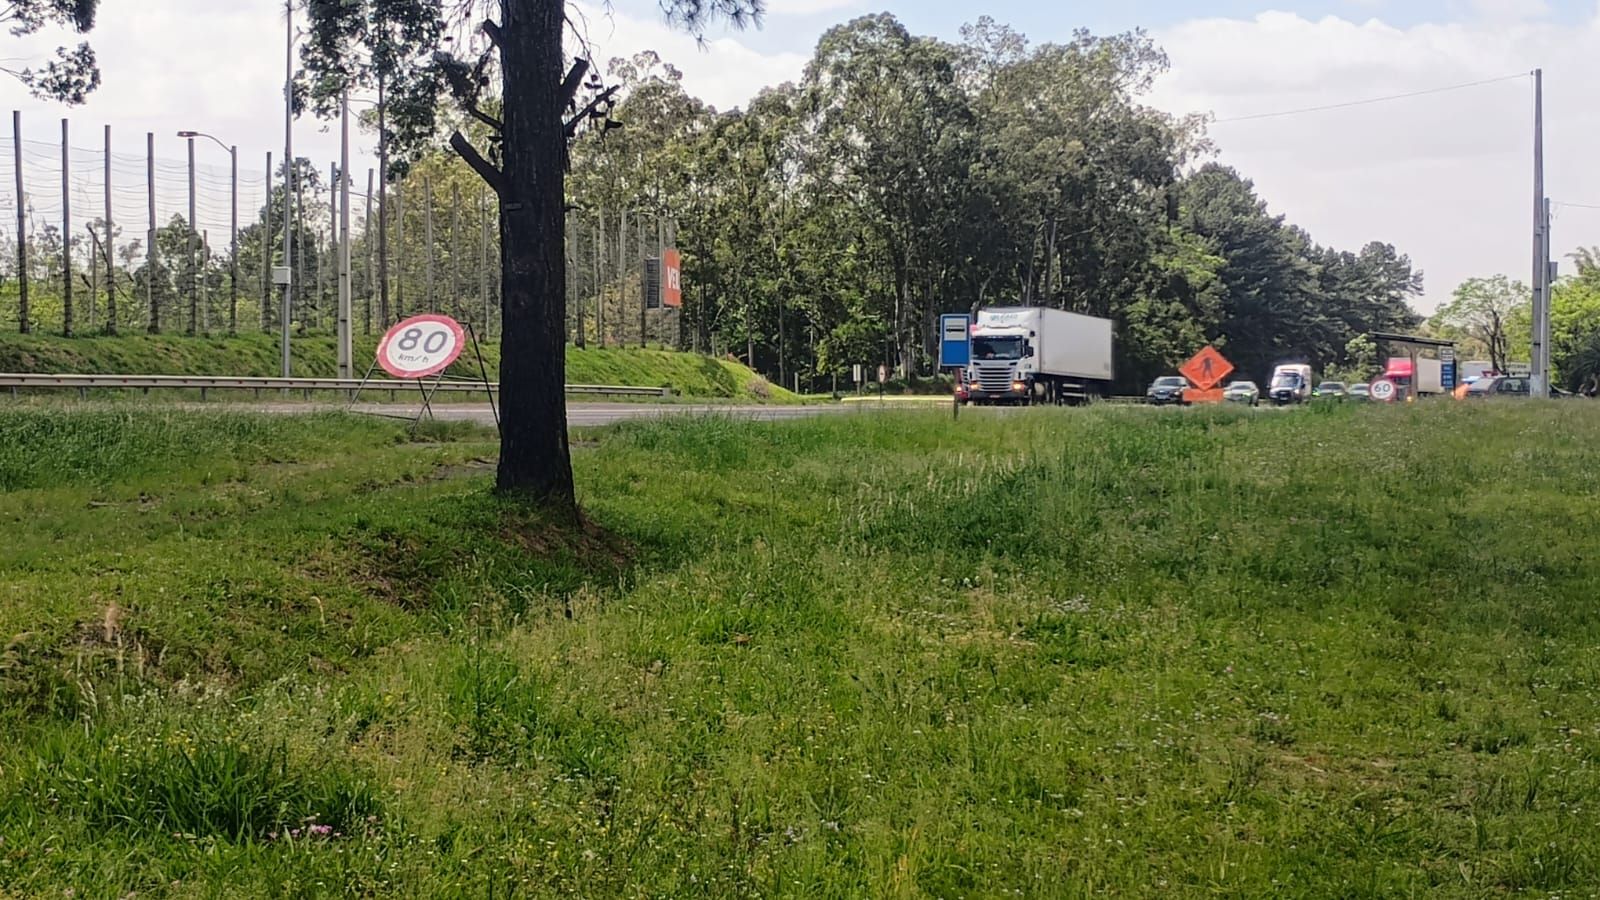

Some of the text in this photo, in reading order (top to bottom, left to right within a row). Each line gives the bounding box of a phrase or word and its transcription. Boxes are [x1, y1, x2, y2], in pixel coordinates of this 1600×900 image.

[398, 328, 448, 353] 80
[398, 353, 430, 363] km/h
[1374, 383, 1391, 393] 60
